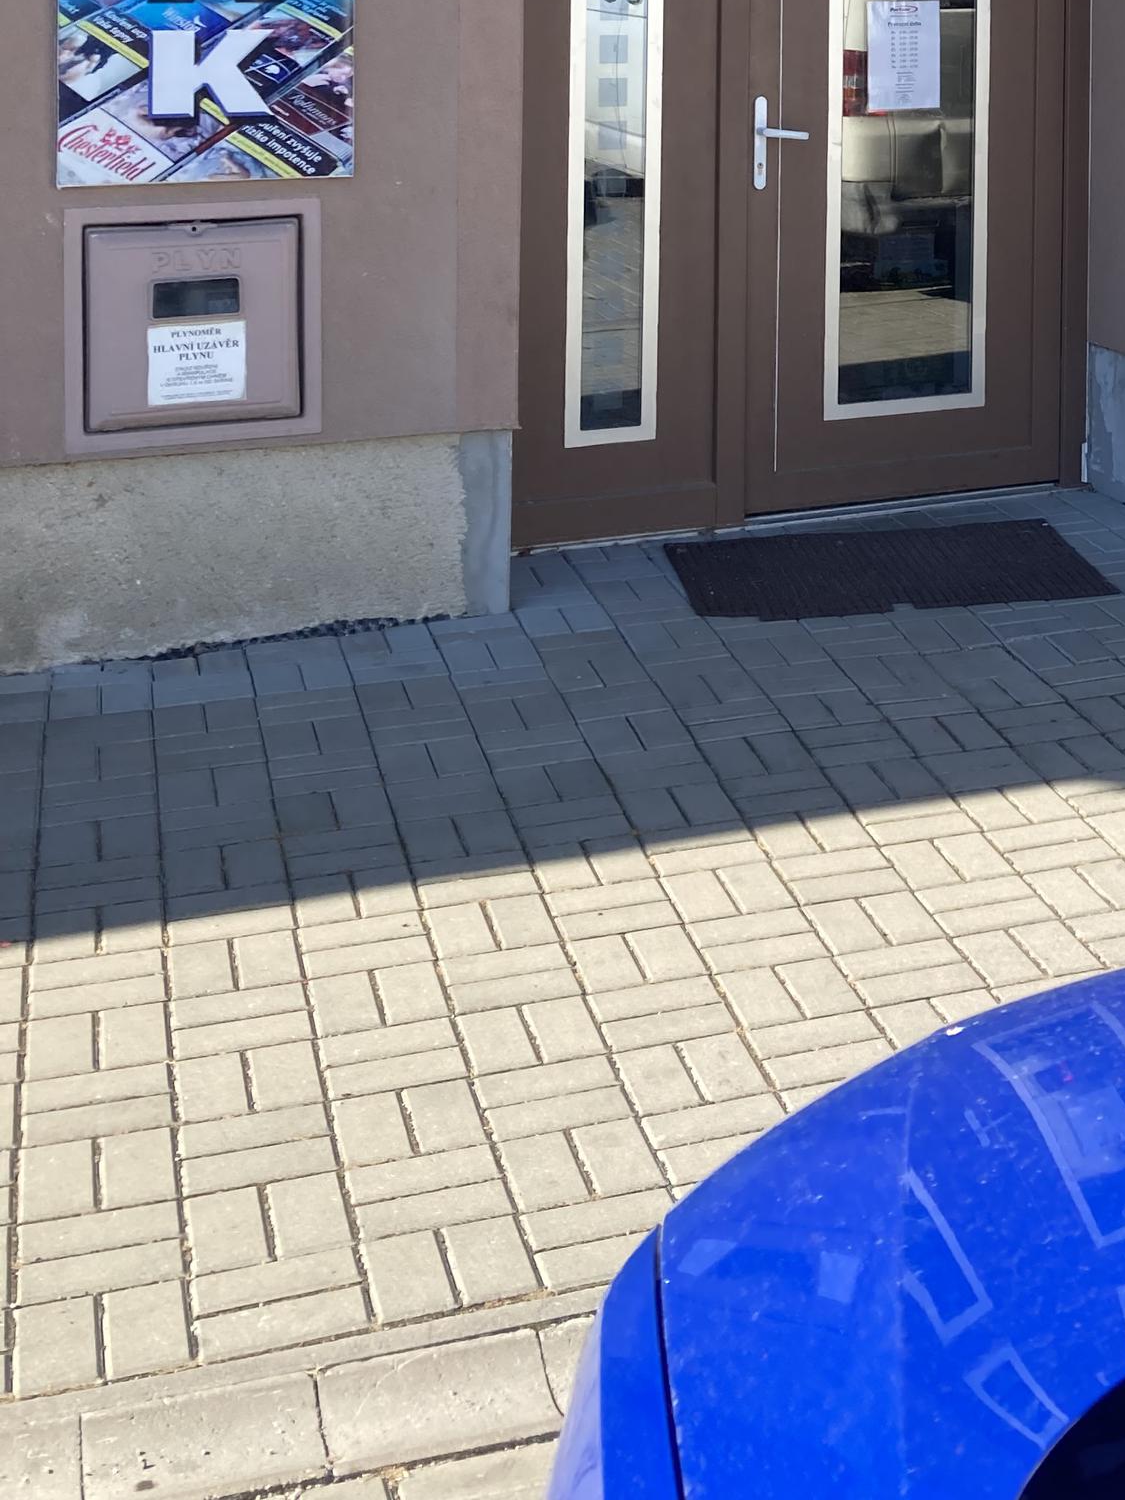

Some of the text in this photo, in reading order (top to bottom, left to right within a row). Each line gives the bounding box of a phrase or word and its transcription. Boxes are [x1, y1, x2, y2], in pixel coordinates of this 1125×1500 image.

[55, 124, 156, 181] Chesterfield
[241, 125, 317, 175] riziko impotence
[286, 136, 323, 163] zvyšuje
[171, 327, 222, 339] PLYNOMĚR
[153, 338, 240, 354] HLAVNÍ UZÁVĚR
[179, 351, 215, 362] PLYNU
